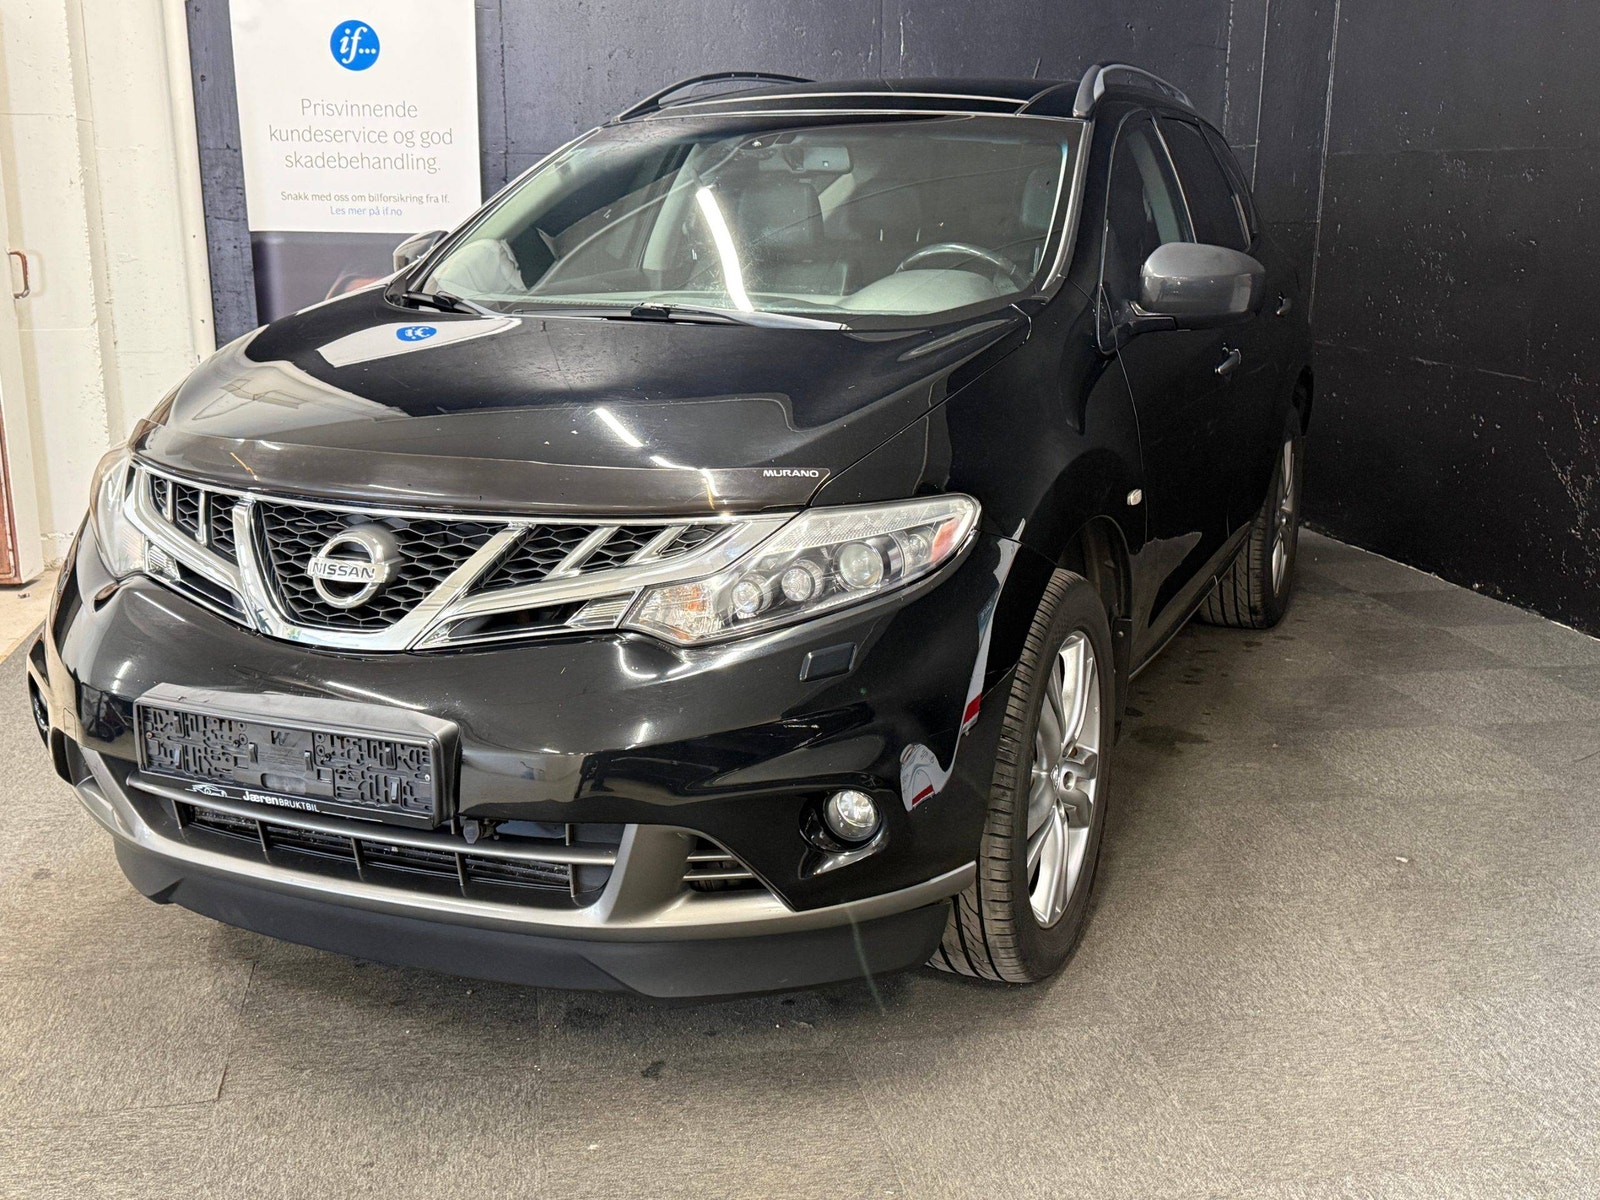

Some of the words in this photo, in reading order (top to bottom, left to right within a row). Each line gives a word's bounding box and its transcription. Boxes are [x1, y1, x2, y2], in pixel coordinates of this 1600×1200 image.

[301, 98, 418, 118] Prisvinnende
[269, 124, 388, 144] kundeservice
[393, 130, 416, 148] og
[420, 128, 453, 148] god
[285, 151, 441, 174] skadebehandling.
[280, 191, 309, 201] Snakk
[311, 192, 332, 201] med
[333, 193, 349, 202] oss
[351, 193, 366, 202] om
[368, 193, 424, 205] bilforsikring
[426, 194, 439, 204] fra
[330, 205, 346, 215] Les
[348, 207, 366, 216] mer
[369, 207, 380, 217] på
[762, 469, 819, 478] MURANO
[312, 562, 375, 579] NISSAN
